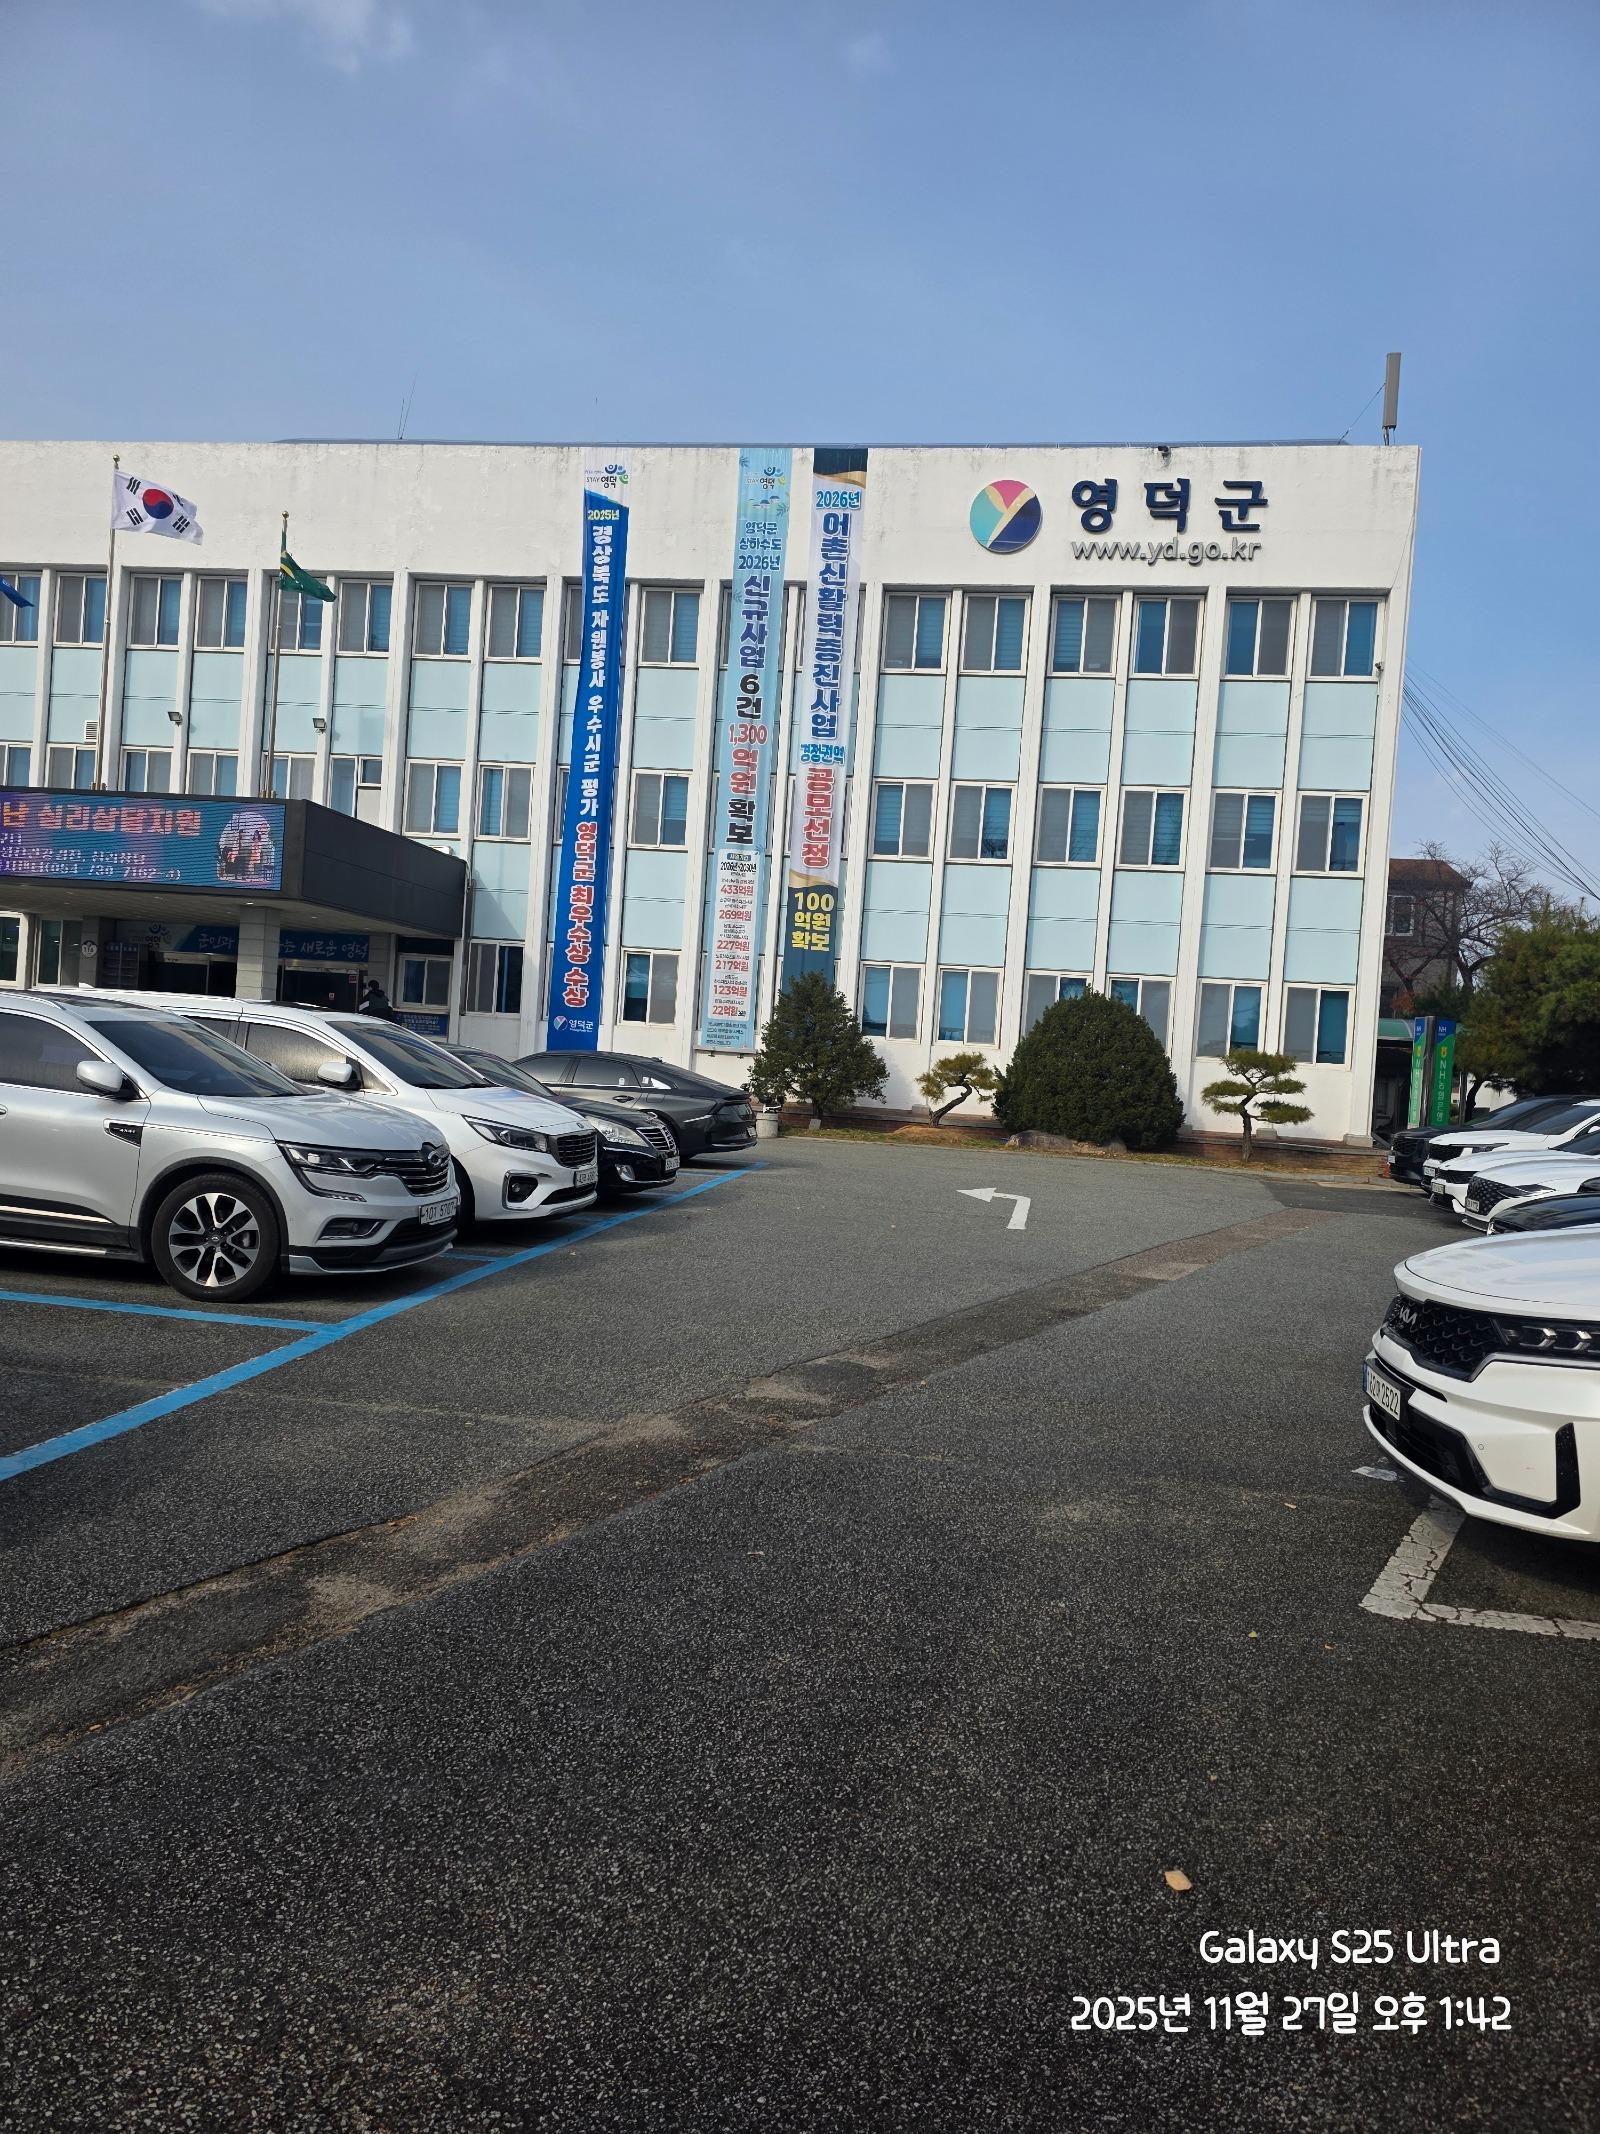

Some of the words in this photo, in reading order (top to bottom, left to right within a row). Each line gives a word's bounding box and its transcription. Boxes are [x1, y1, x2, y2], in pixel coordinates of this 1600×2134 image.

[601, 476, 617, 489] 영덕
[760, 477, 776, 490] 영덕
[816, 490, 862, 509] 2026년
[1071, 478, 1269, 533] 영덕군
[587, 509, 620, 520] 2025년
[745, 521, 778, 535] 영덕군
[739, 537, 782, 551] 상하수도
[1071, 536, 1261, 566] www.yd.go.kr
[591, 525, 613, 604] 경상북도
[738, 554, 781, 571] 2026년
[739, 574, 772, 670] 신규사업
[589, 609, 609, 688] 자원봉사
[736, 673, 763, 720] 6건
[584, 694, 604, 773] 우수시군
[728, 723, 768, 746] 1,300
[730, 748, 760, 795] 억원
[579, 778, 599, 817] 평가
[726, 798, 757, 845] 확보
[802, 767, 835, 868] 공모선정
[573, 821, 598, 883] 영덕군
[720, 885, 754, 896] 433억원
[795, 892, 835, 912] 100
[565, 884, 595, 965] 최우수상
[719, 910, 752, 921] 269억원
[794, 911, 831, 932] 억원
[717, 940, 750, 952] 227억원
[791, 931, 830, 951] 확보
[715, 960, 749, 972] 217억원
[563, 967, 589, 1008] 수상
[713, 985, 748, 997] 123억원
[1381, 1382, 1399, 1416] 2522
